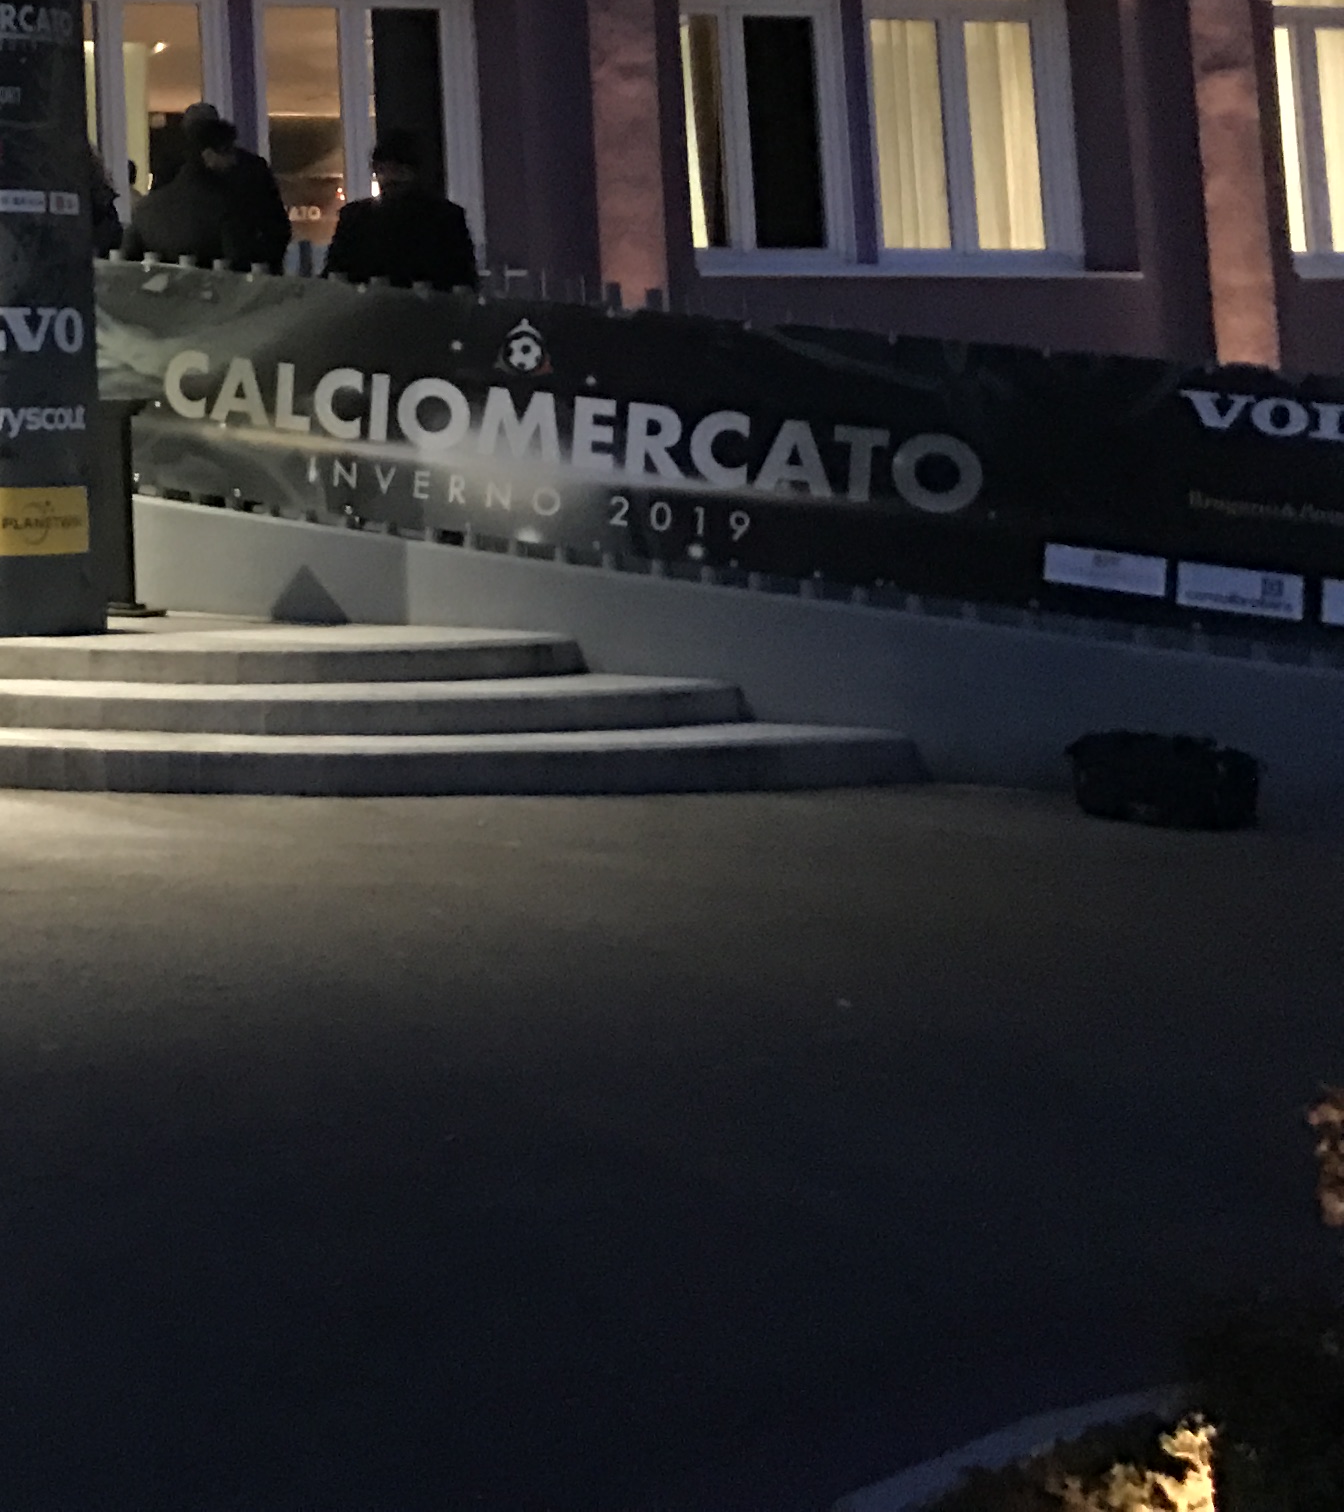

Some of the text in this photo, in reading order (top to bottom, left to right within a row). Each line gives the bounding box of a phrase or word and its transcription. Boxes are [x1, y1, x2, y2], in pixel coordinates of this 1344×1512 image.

[165, 349, 984, 514] CALCIOMERCATO
[308, 456, 751, 542] INVERNO 2019
